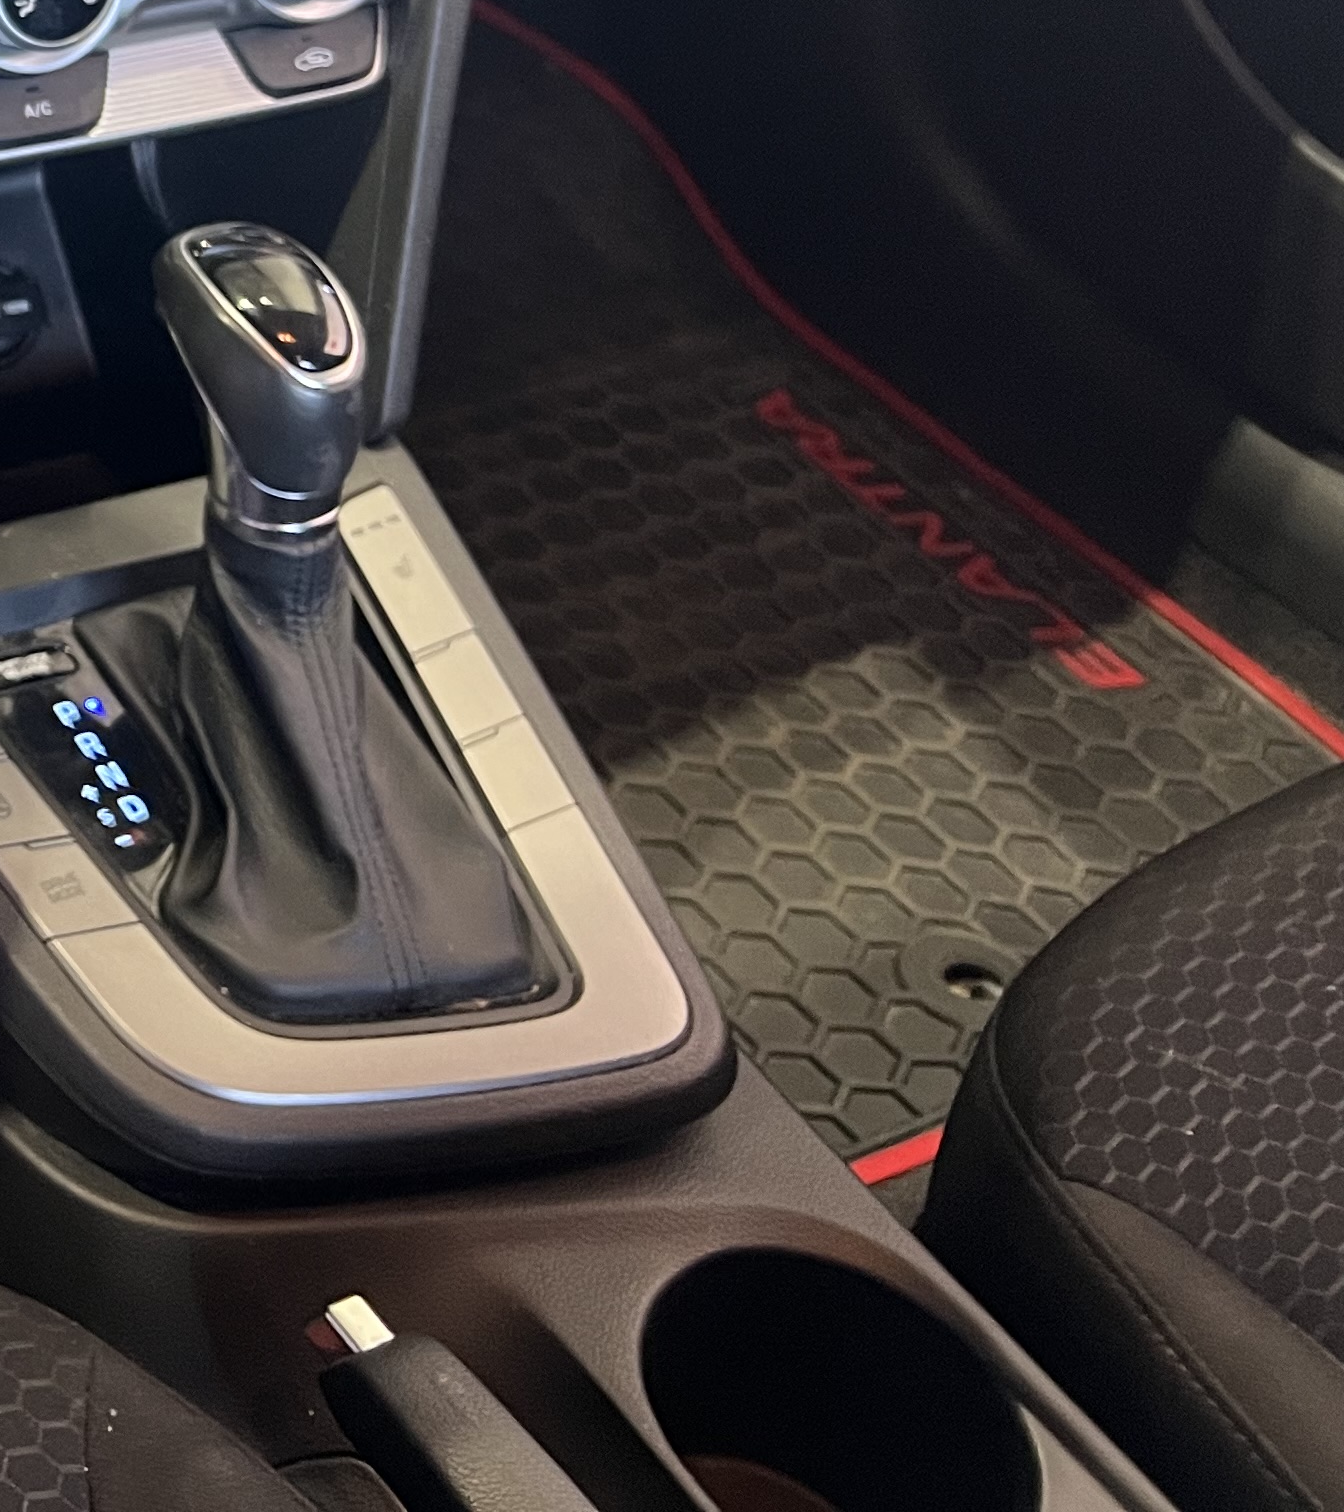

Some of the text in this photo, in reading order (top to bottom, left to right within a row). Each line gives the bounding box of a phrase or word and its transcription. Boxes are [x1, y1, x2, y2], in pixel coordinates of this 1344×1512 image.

[24, 101, 53, 119] A/C
[756, 388, 1148, 688] ELANTRA
[53, 700, 81, 729] P
[74, 731, 108, 760] R
[95, 761, 130, 791] N
[117, 794, 150, 824] D
